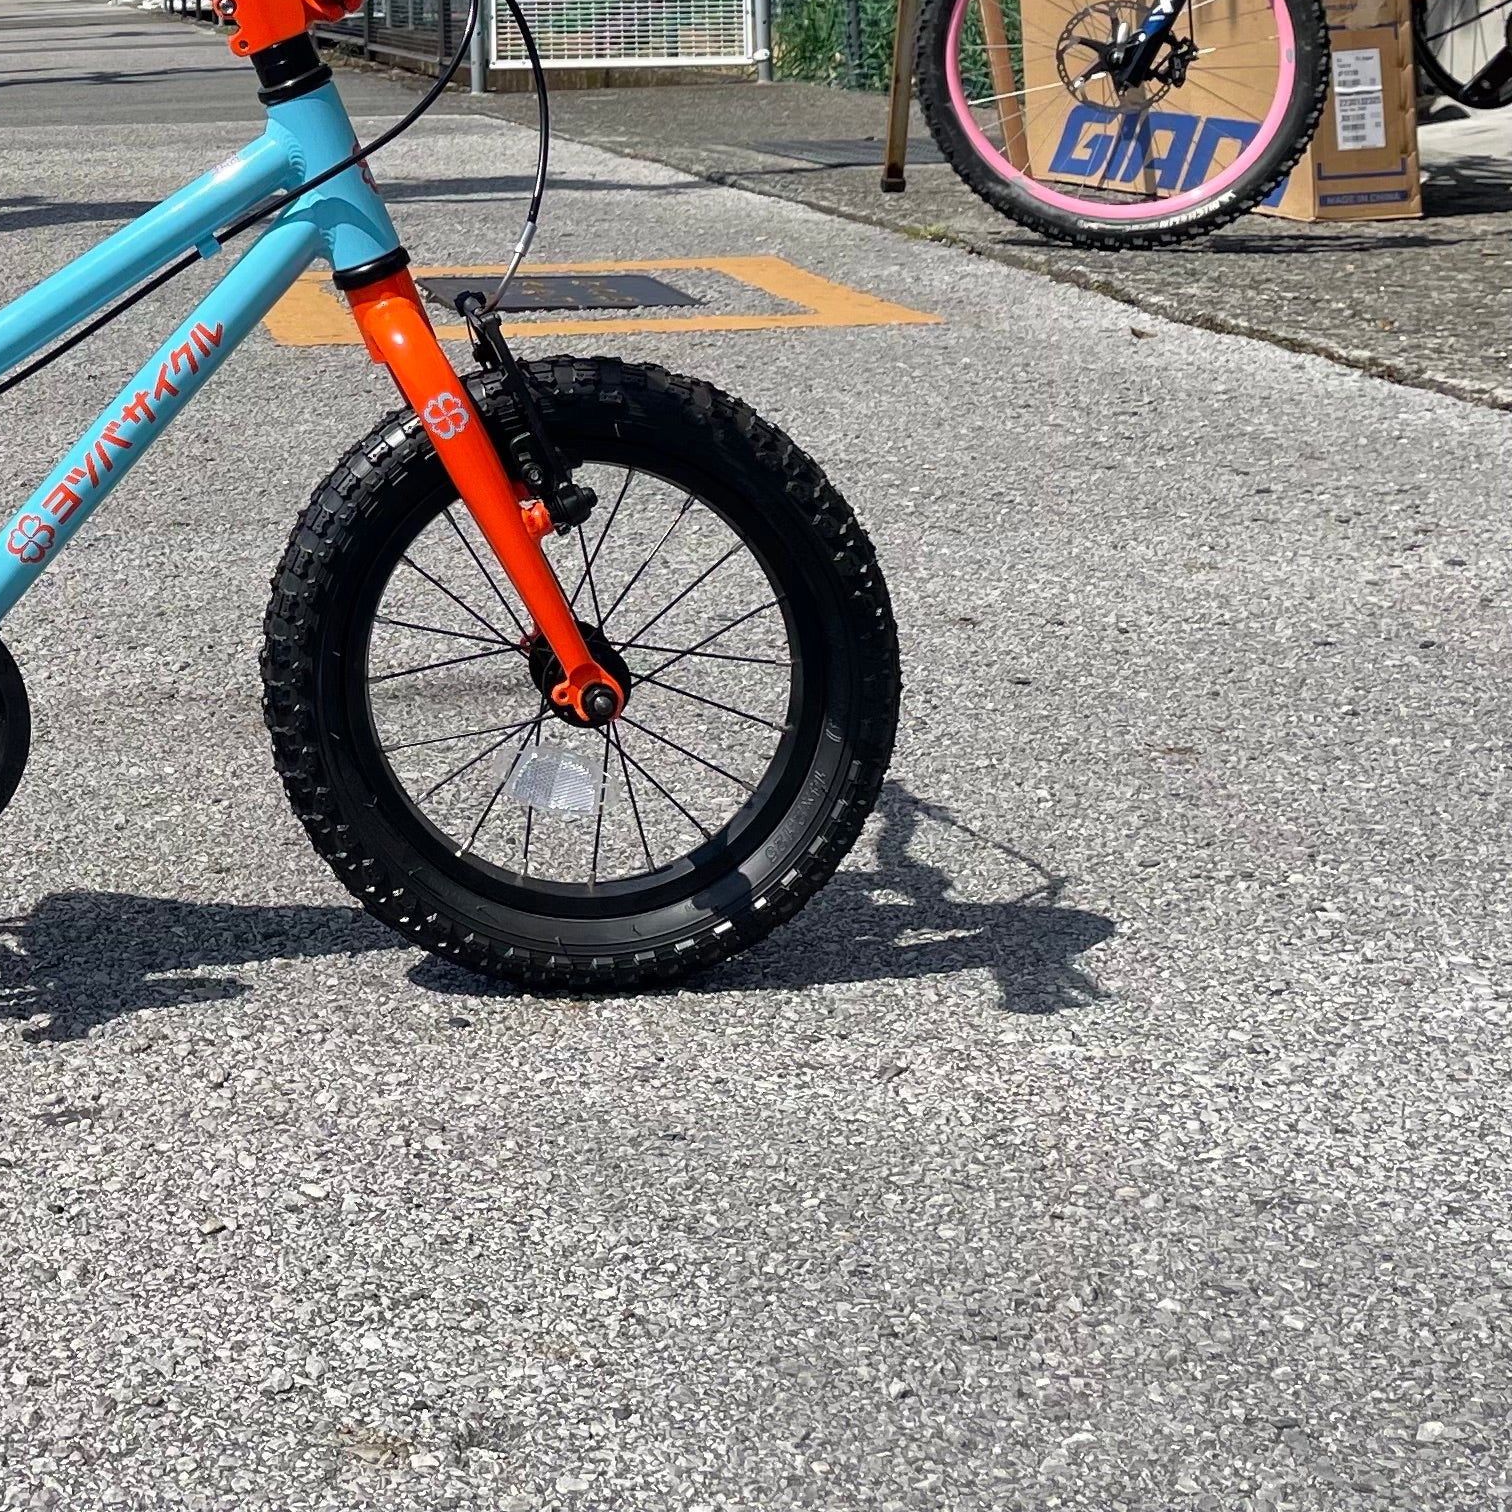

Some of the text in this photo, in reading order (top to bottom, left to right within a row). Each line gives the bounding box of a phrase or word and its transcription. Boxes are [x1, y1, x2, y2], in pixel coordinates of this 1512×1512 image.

[1048, 104, 1288, 207] GIAN
[42, 322, 223, 525] ヨツバサイクル
